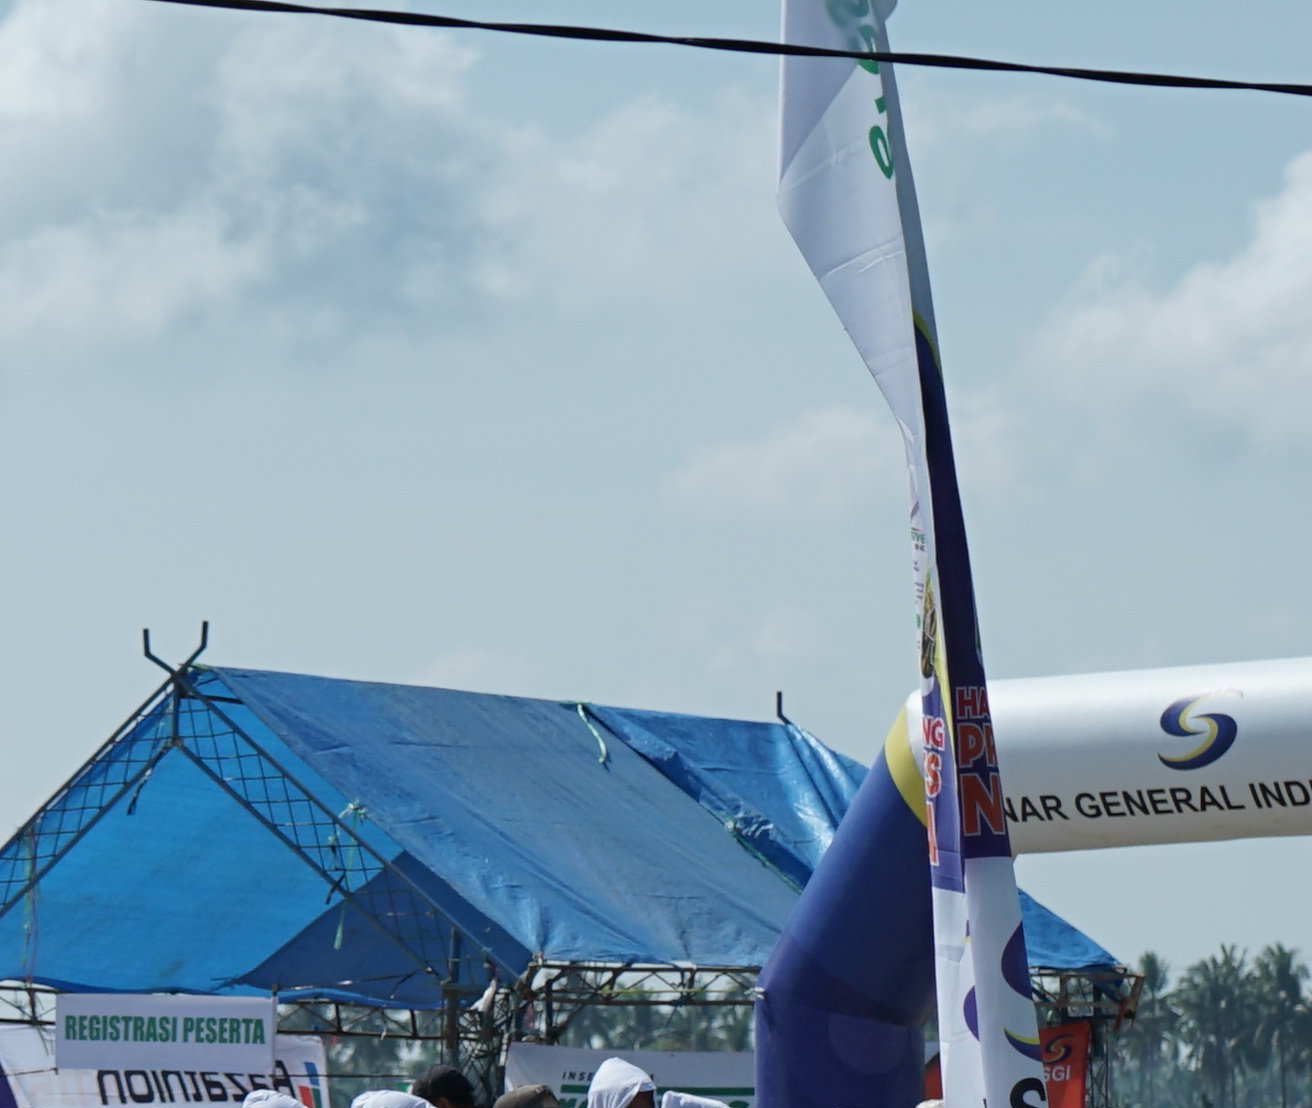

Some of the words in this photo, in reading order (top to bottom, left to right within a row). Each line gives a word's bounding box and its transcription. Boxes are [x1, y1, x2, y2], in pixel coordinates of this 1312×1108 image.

[1004, 794, 1070, 823] NAR
[1075, 784, 1245, 818] GENERAL
[65, 1015, 177, 1042] REGISTRASI
[182, 1017, 266, 1045] PESERTA
